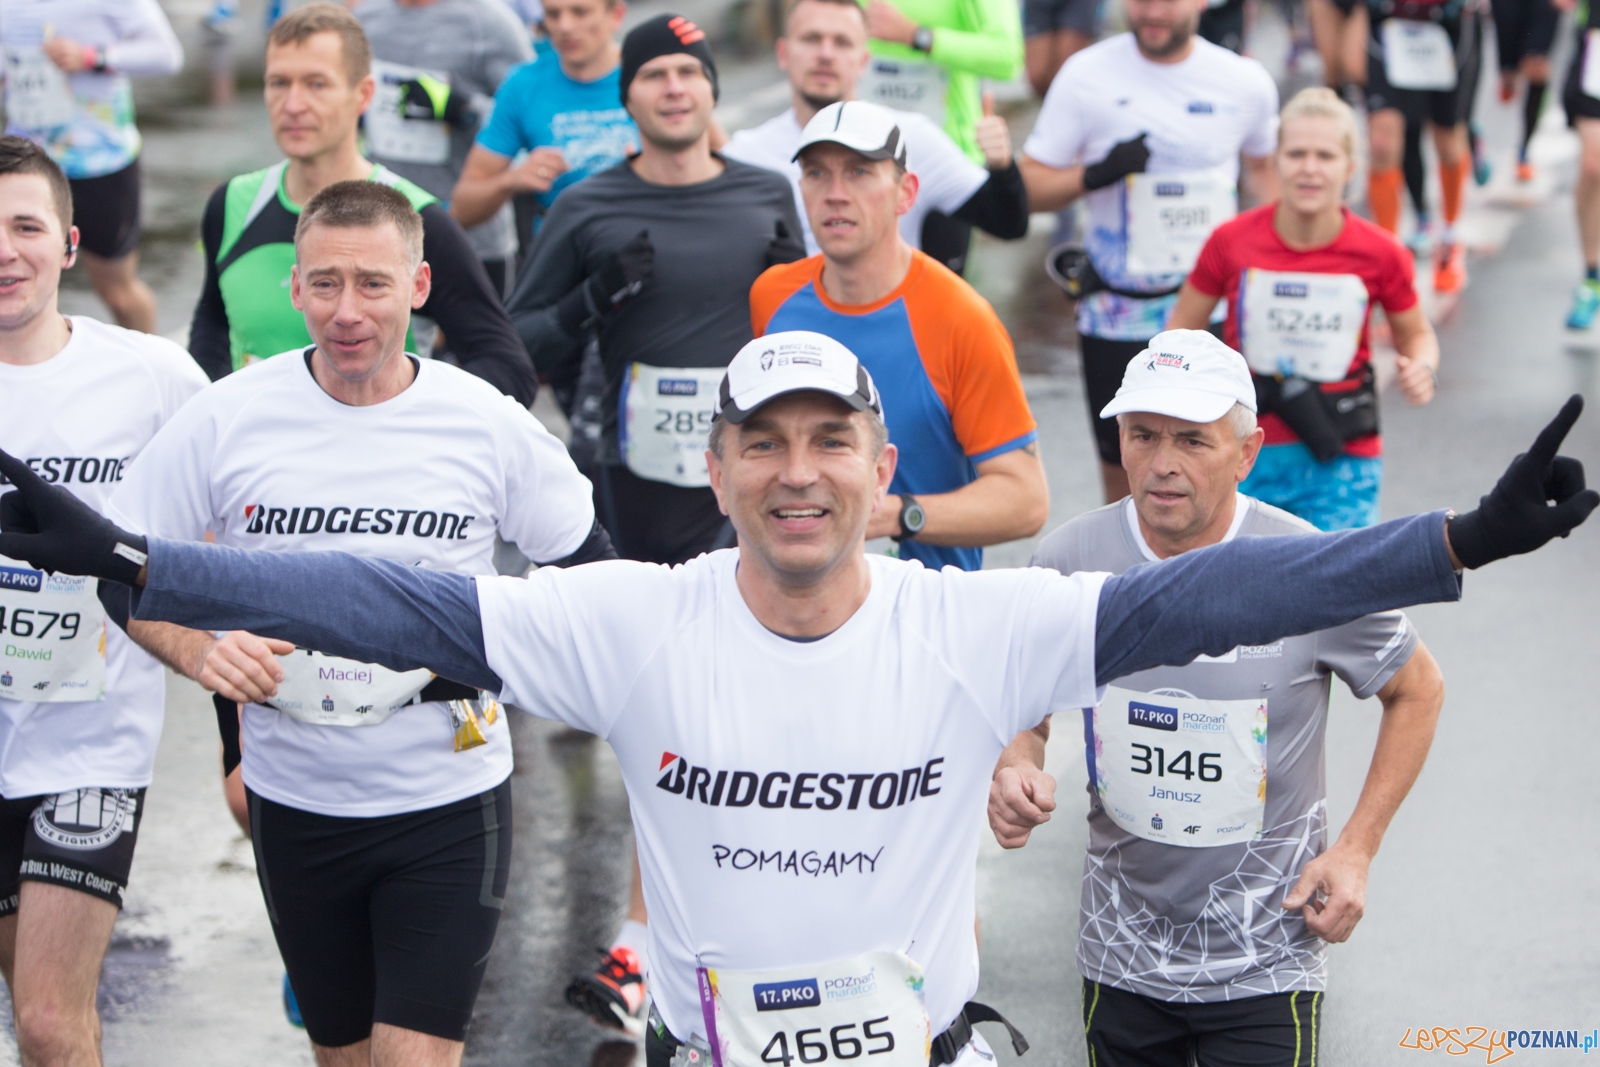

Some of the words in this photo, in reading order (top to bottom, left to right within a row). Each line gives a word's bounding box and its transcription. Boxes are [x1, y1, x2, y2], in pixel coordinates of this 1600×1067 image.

[1267, 309, 1342, 333] 5244
[654, 409, 712, 434] 285
[245, 504, 475, 539] BRIDGESTONE
[5, 644, 52, 661] Dawid
[318, 667, 373, 684] Maciej
[1131, 742, 1223, 783] 3146
[656, 751, 945, 810] BRIDGESTONE
[1148, 785, 1202, 804] Janusz
[50, 862, 85, 884] WEST
[712, 844, 885, 877] POMAGAMY
[760, 1015, 896, 1067] 4665
